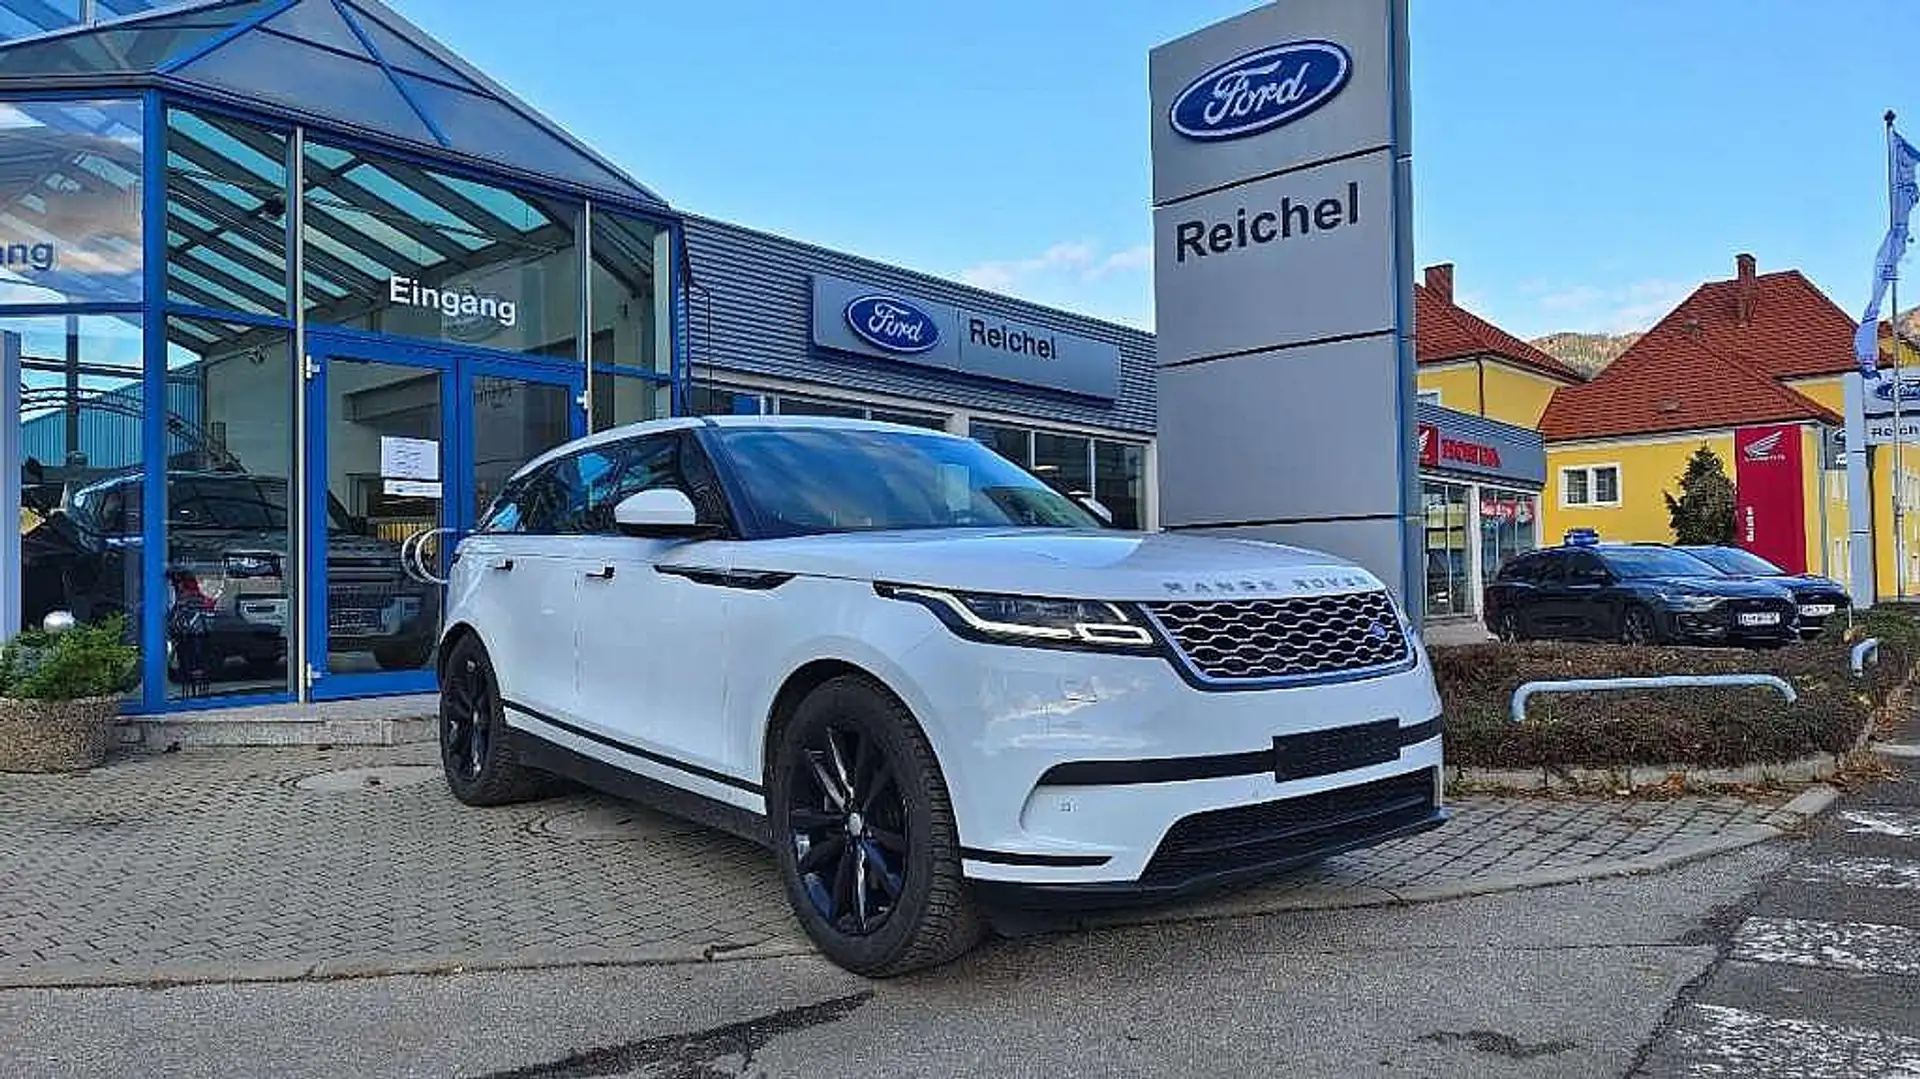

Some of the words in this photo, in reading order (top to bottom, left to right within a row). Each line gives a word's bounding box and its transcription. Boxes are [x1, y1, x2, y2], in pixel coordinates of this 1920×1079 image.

[1203, 60, 1311, 125] Ford
[1176, 182, 1359, 263] Reichel
[0, 242, 54, 271] ng
[390, 275, 516, 327] Eingang
[868, 302, 924, 342] Ford
[969, 318, 1056, 360] Reichel
